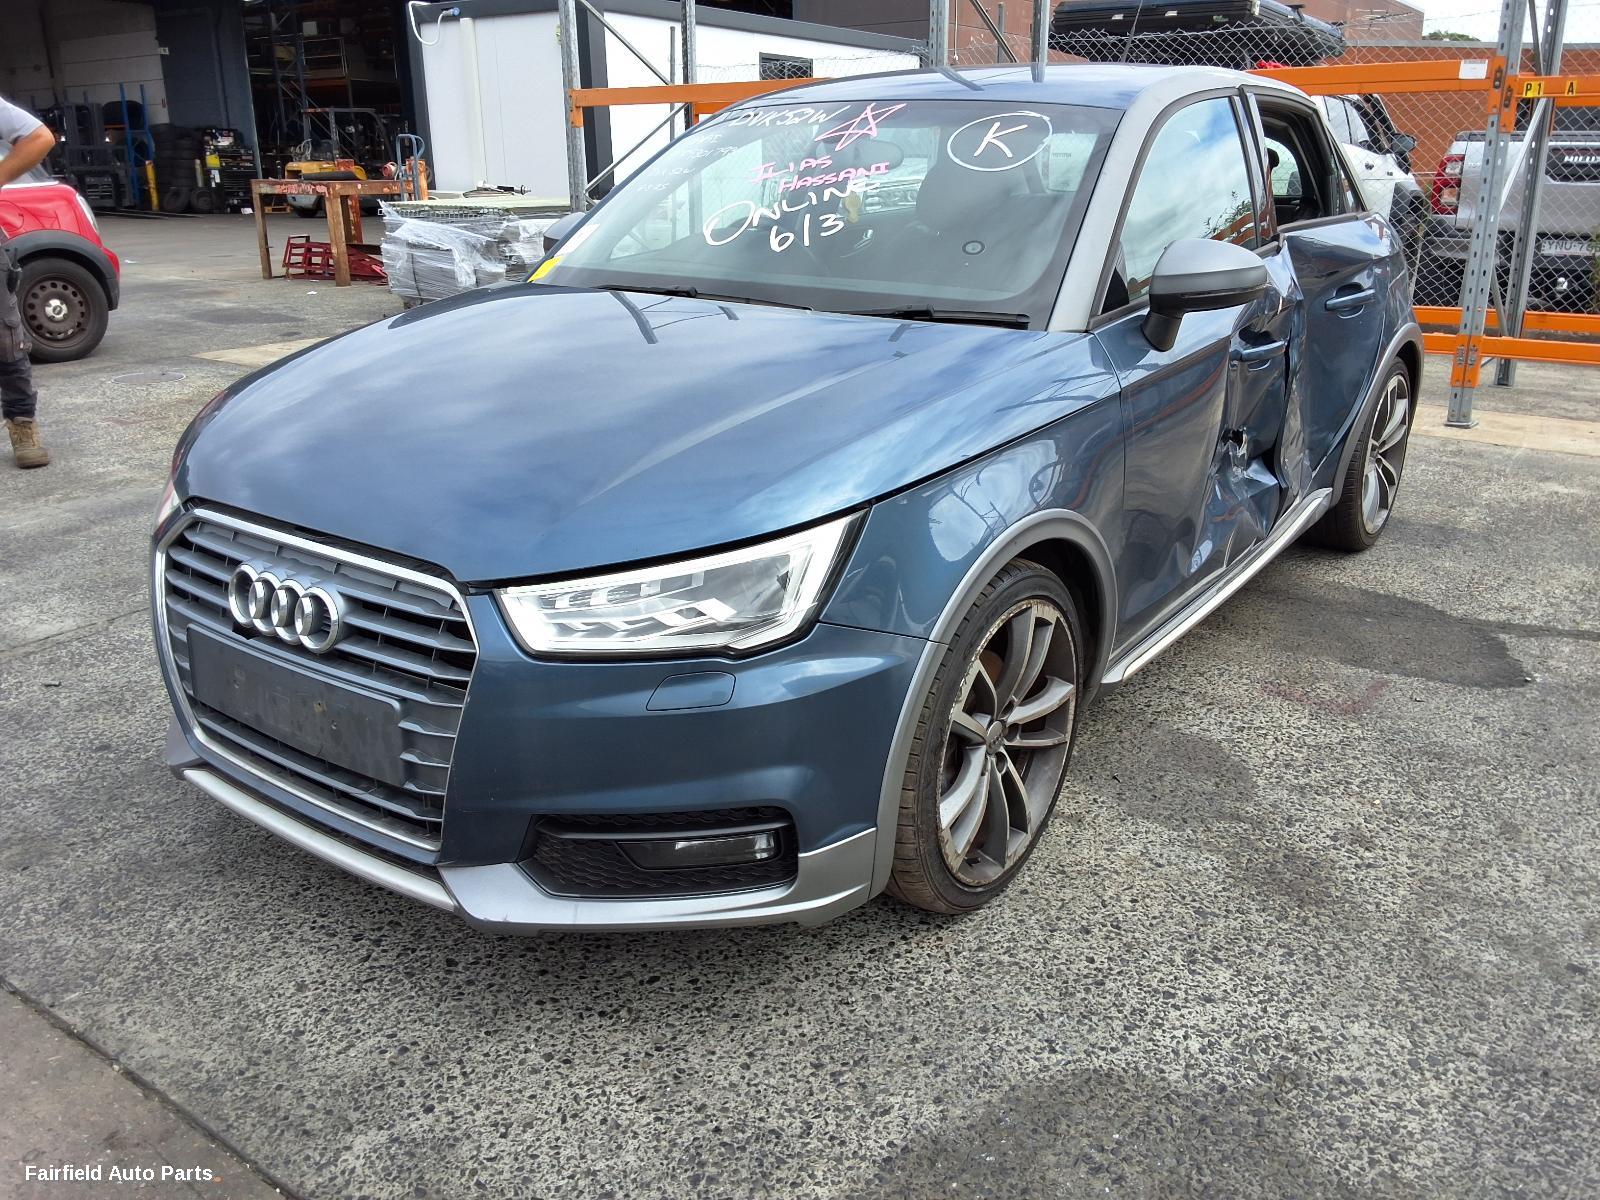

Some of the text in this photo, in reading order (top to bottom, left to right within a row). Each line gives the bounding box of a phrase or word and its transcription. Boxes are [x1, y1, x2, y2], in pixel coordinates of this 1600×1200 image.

[1567, 81, 1574, 95] A
[973, 121, 1028, 158] K
[752, 155, 833, 184] ILIAS
[778, 162, 890, 193] HASSANI
[703, 178, 881, 246] ONLINE
